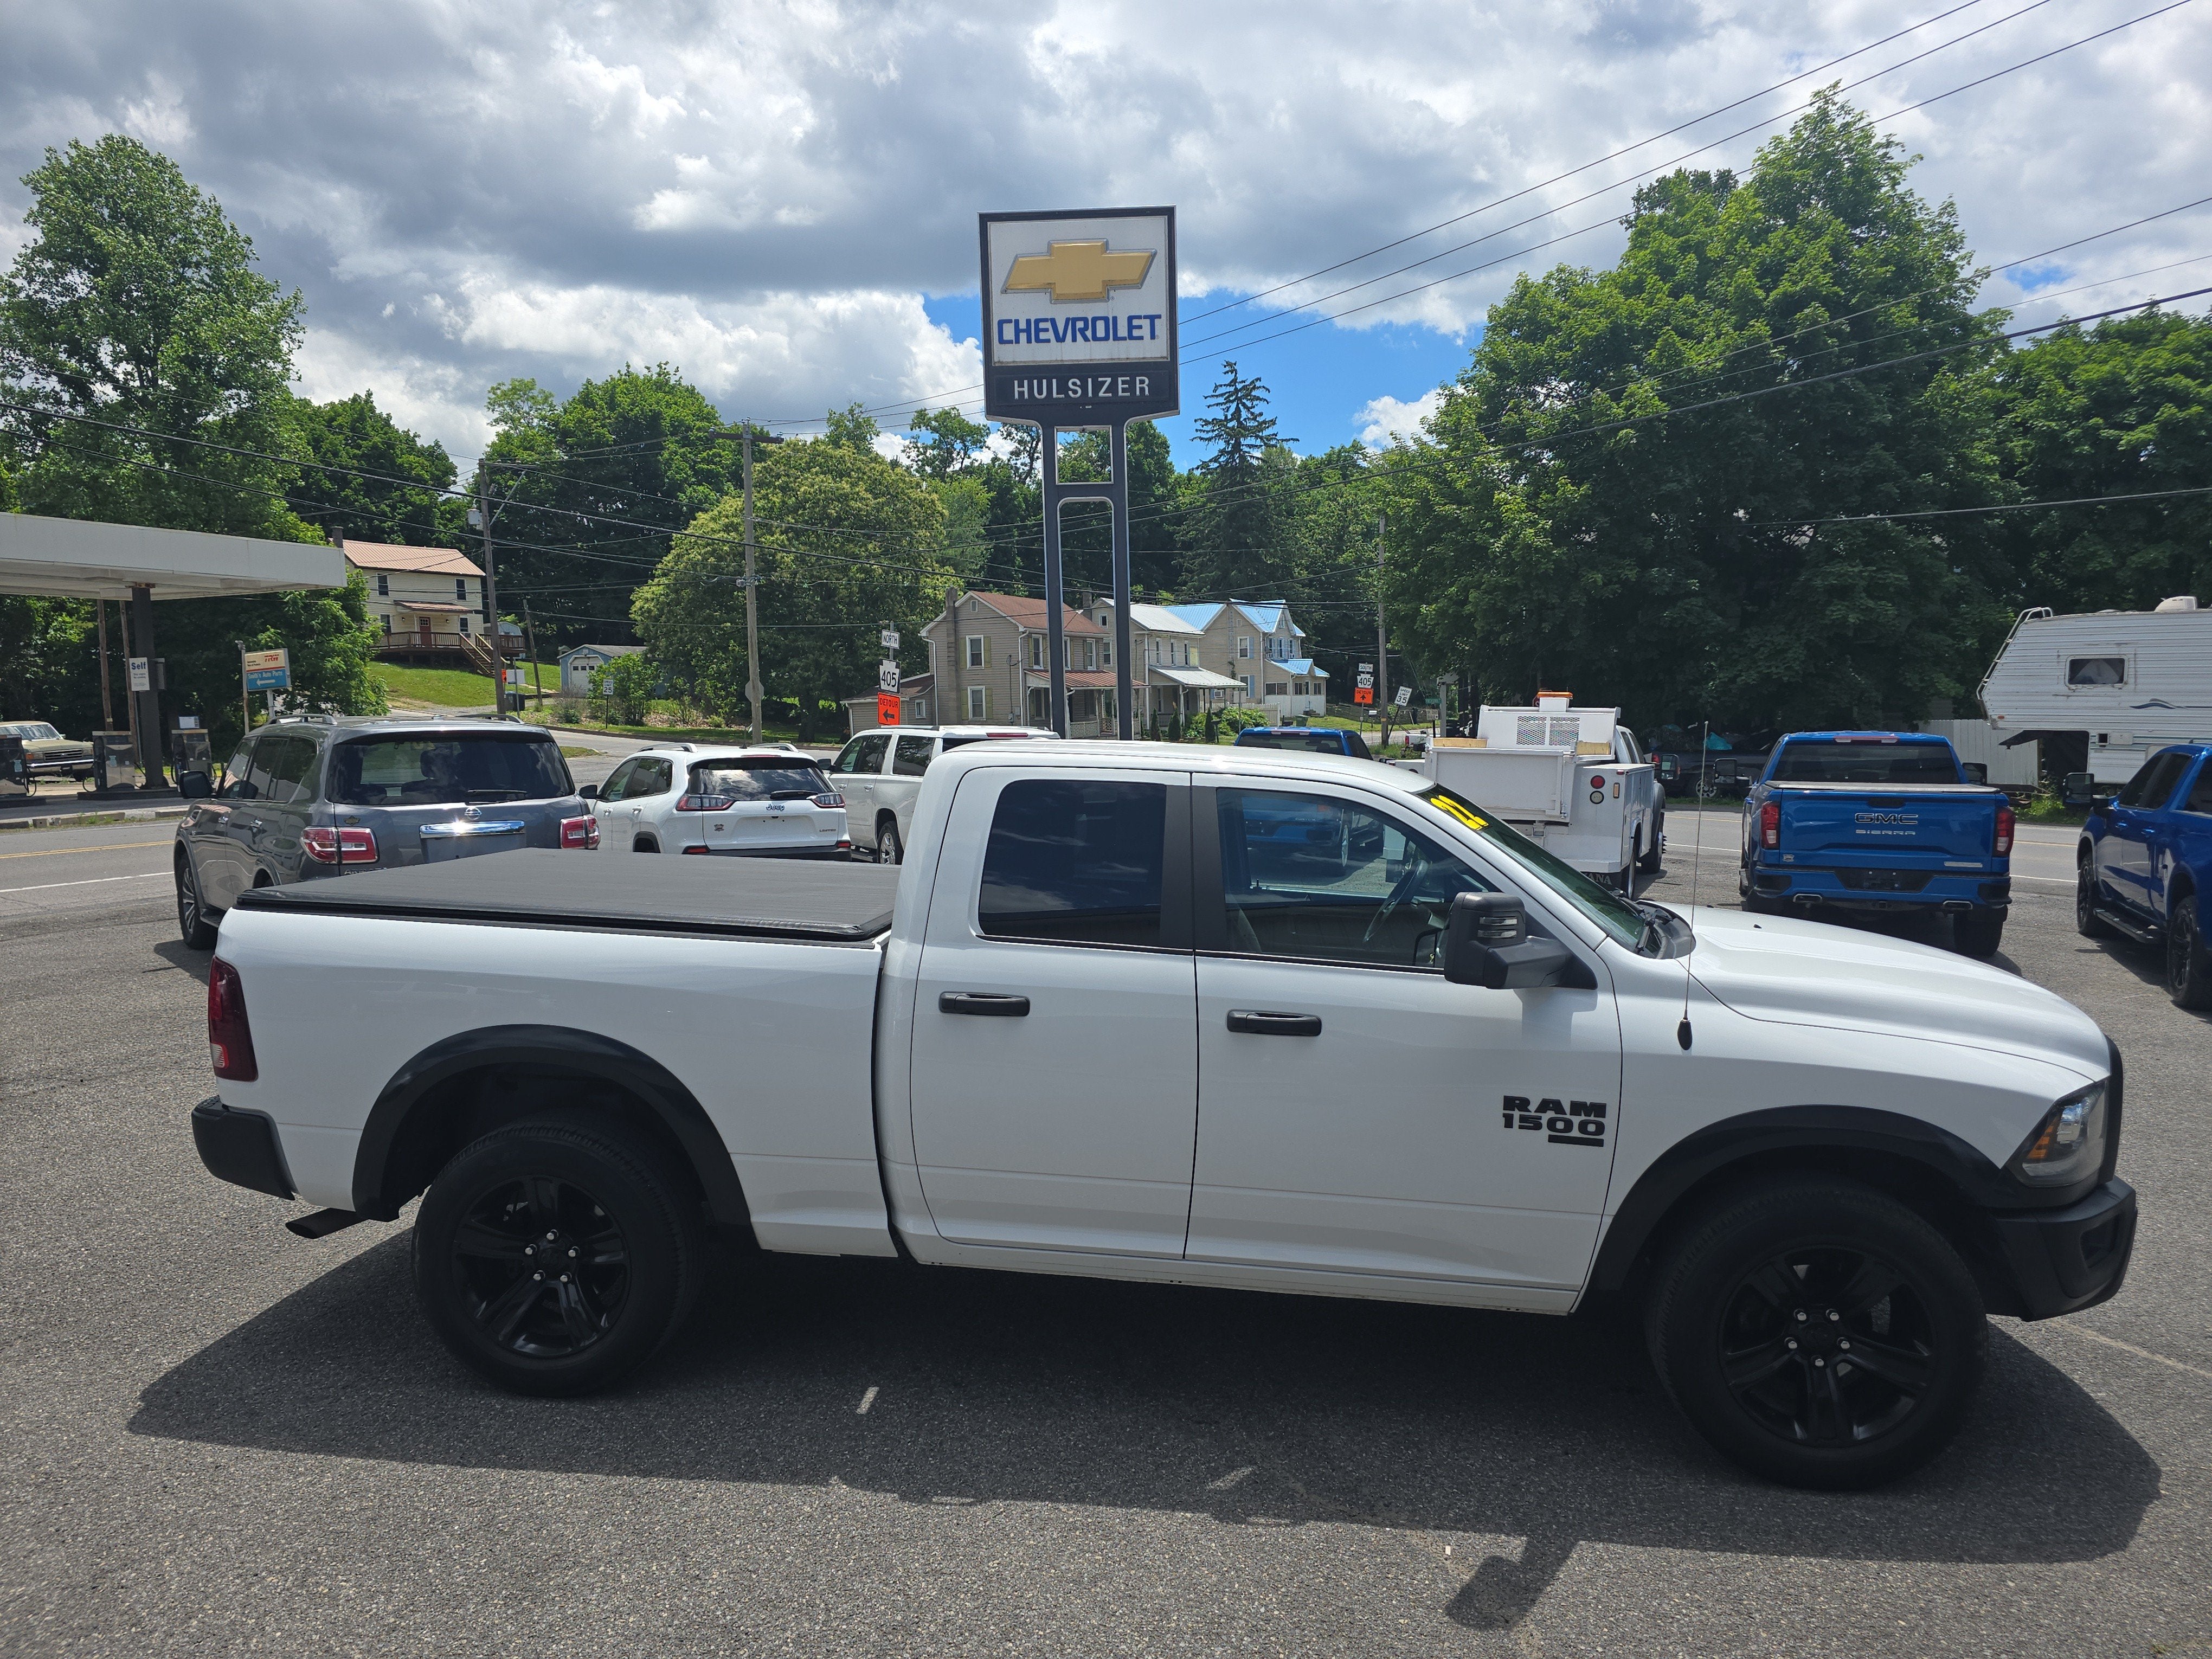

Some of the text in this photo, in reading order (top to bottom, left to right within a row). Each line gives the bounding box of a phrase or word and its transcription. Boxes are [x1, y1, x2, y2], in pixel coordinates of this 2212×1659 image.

[998, 314, 1162, 344] CHEVROLET
[1014, 376, 1150, 400] HULSIZER
[883, 634, 898, 645] NORTH
[131, 661, 146, 670] Self
[881, 670, 897, 688] 405
[1358, 677, 1372, 686] 405
[879, 697, 898, 708] DETOUR
[1396, 696, 1407, 704] 35
[766, 803, 785, 812] Jeep
[1855, 812, 1919, 825] GMC
[1502, 1095, 1607, 1118] RAM
[1502, 1113, 1605, 1136] 1500
